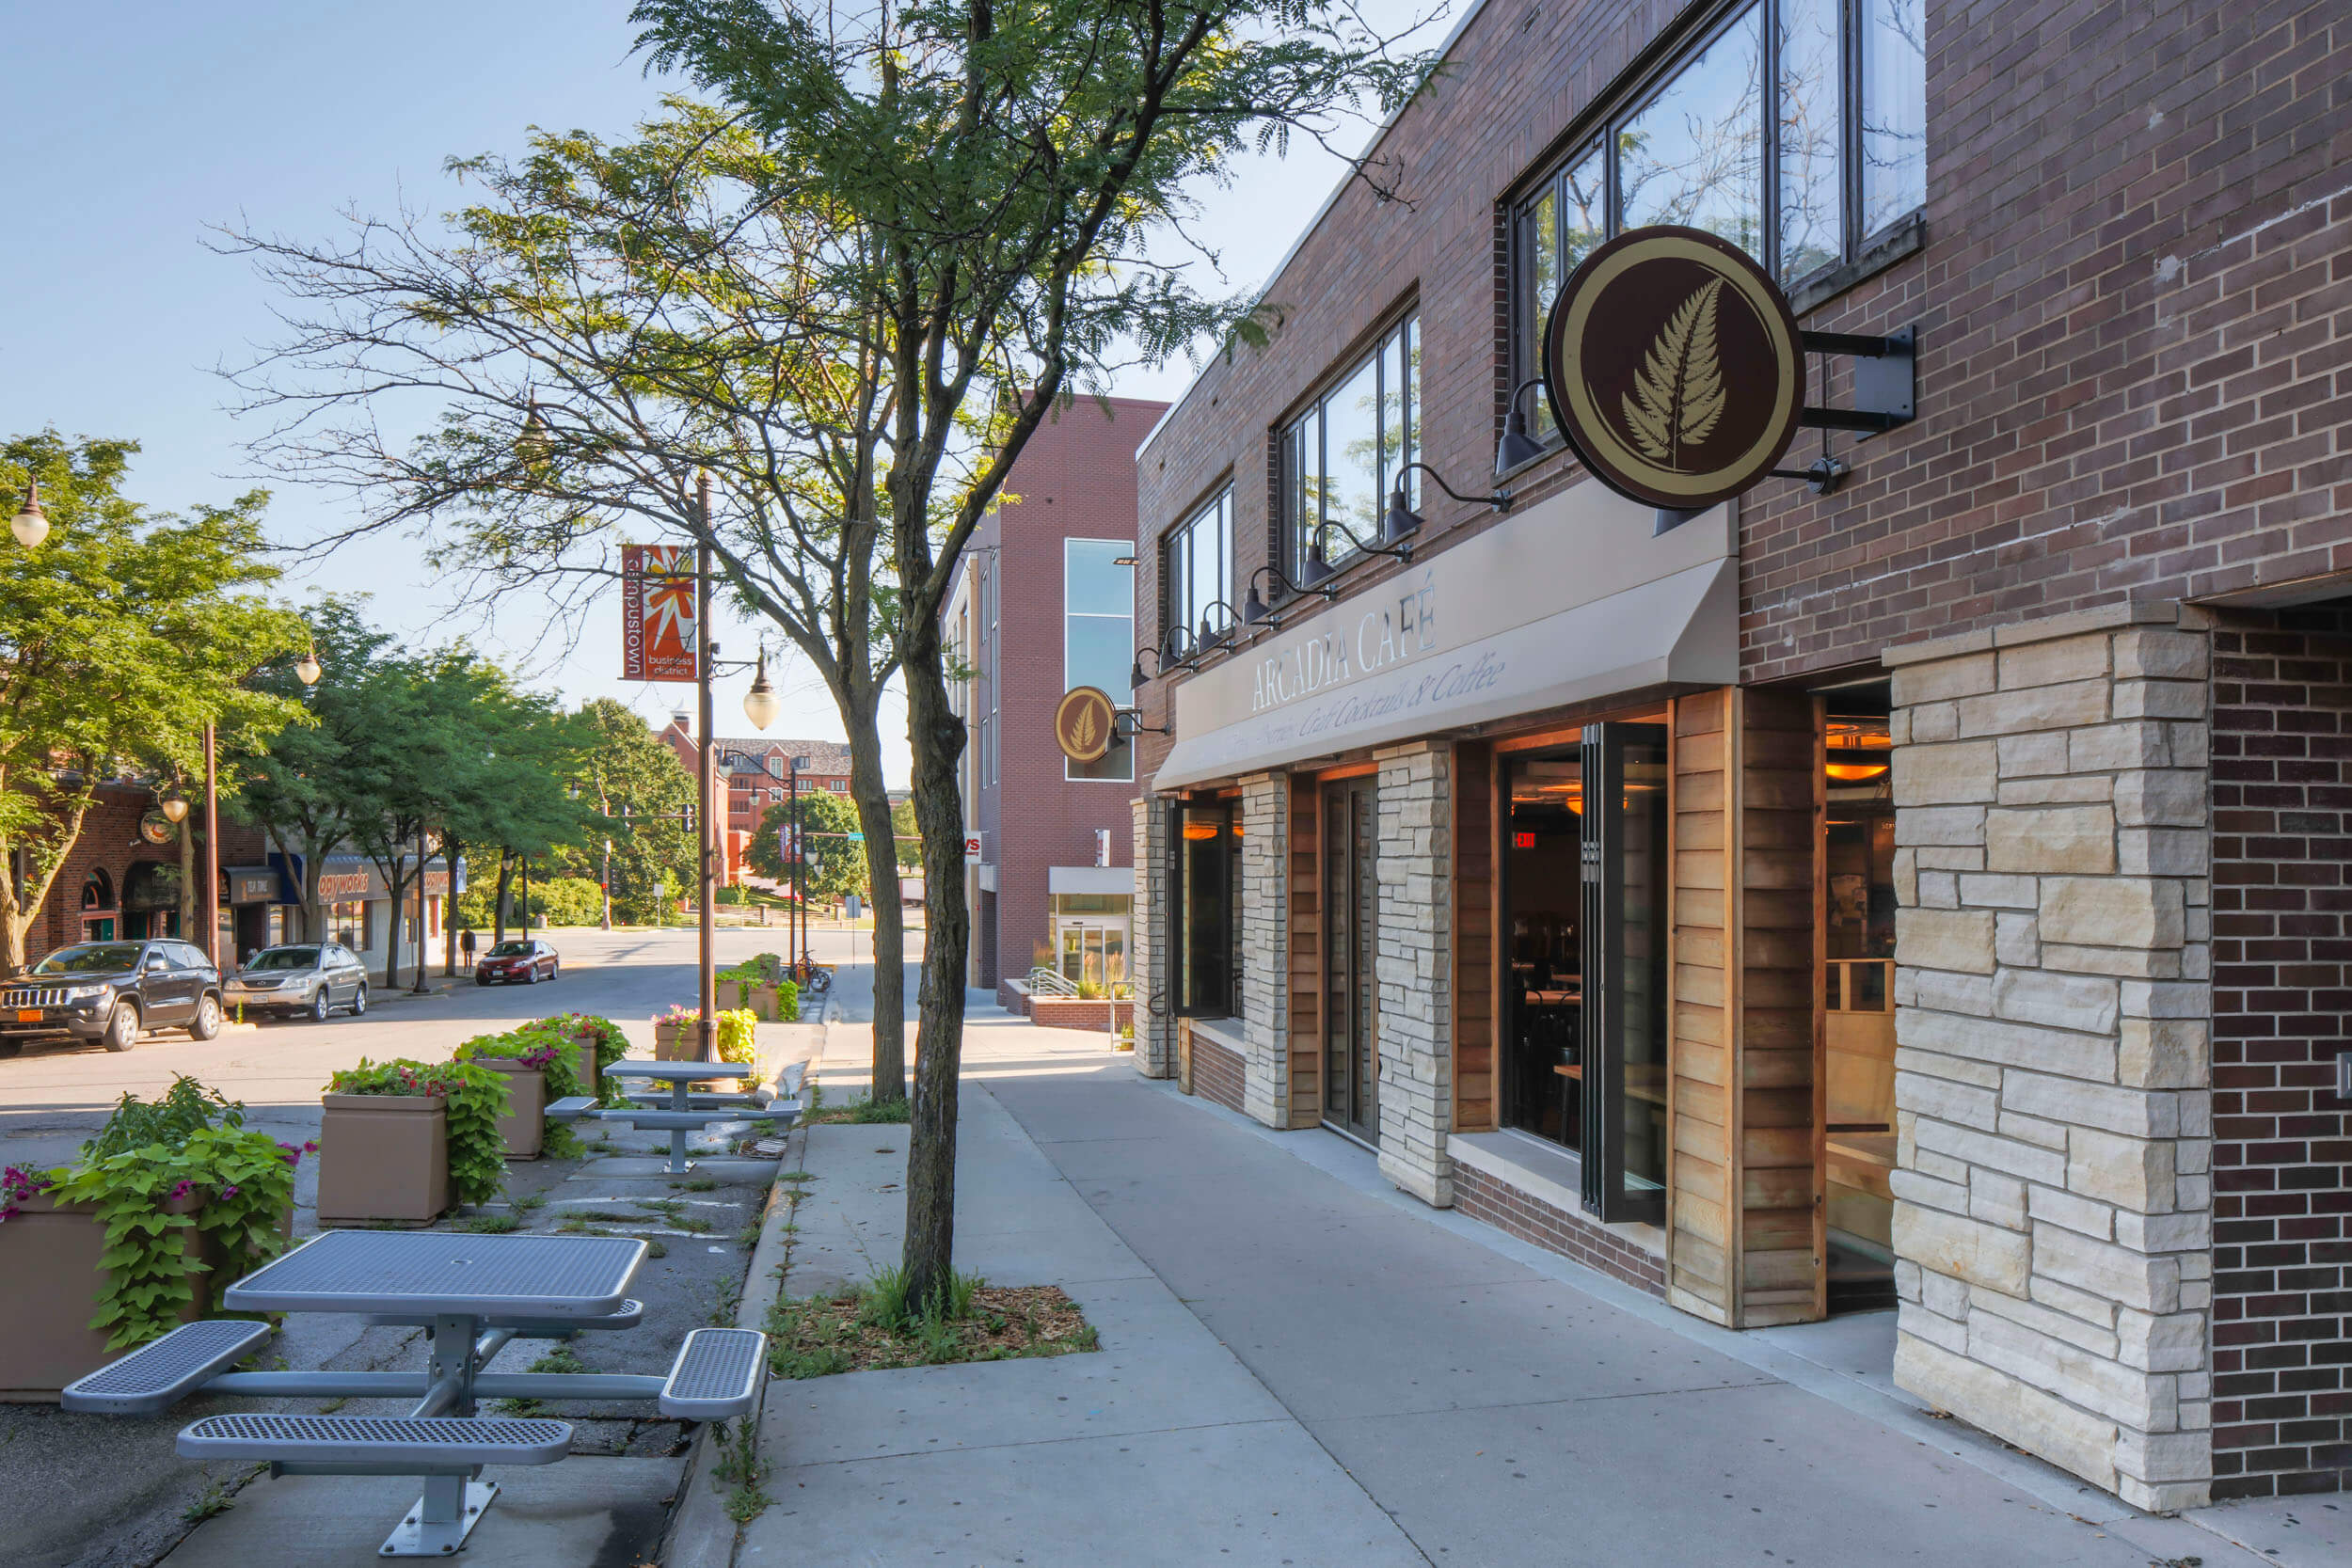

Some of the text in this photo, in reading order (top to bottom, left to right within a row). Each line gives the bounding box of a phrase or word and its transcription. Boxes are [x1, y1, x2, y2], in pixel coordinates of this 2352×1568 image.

[1252, 568, 1437, 712] ARCADIA CAFÉ
[1299, 651, 1506, 737] Craft Cocktails & Coffee
[1517, 832, 1535, 847] EXIT
[318, 865, 370, 902] opyworks
